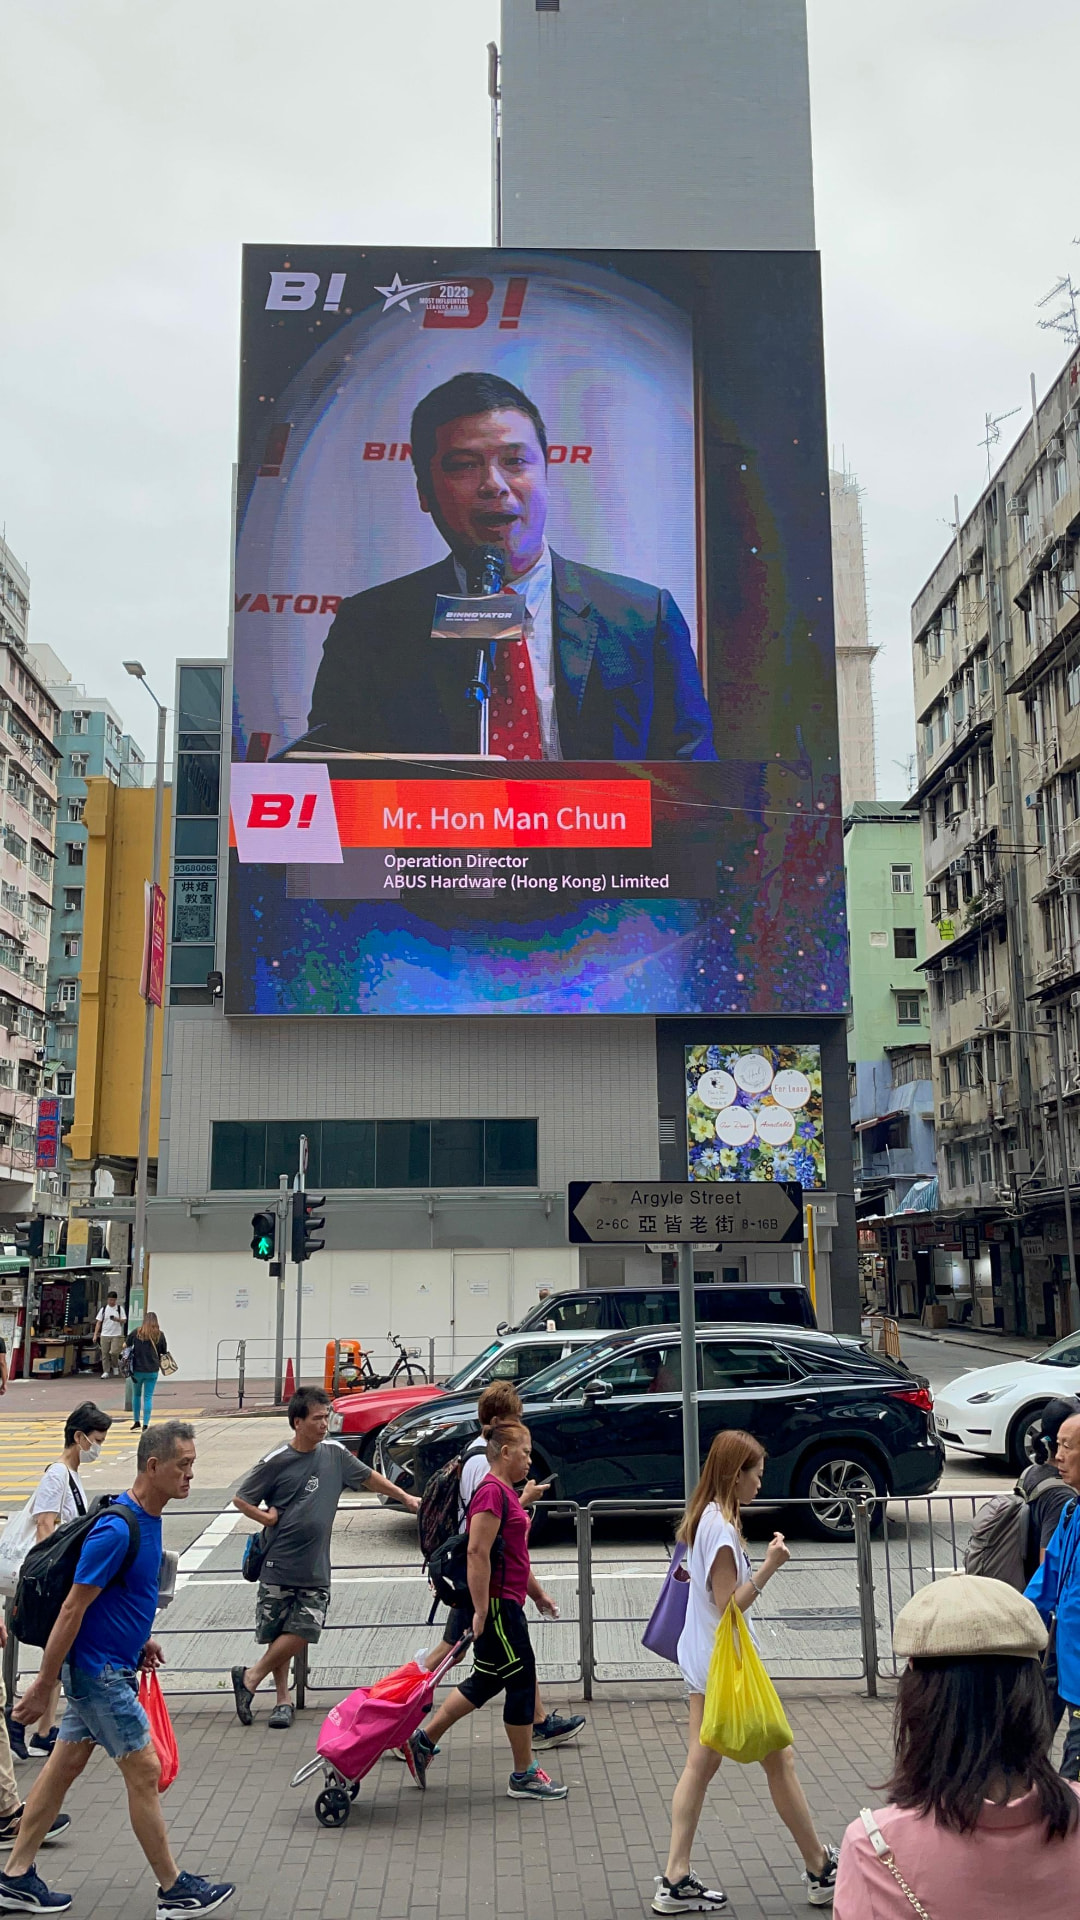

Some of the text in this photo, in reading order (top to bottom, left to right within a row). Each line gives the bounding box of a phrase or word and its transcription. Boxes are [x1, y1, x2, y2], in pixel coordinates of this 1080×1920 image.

[265, 271, 347, 311] B!
[439, 286, 468, 298] 2023
[246, 794, 318, 829] B!
[382, 806, 627, 831] Mr. Hon Man Chun
[384, 854, 529, 871] Operation Director
[181, 881, 209, 892] 烘焙
[383, 873, 669, 893] ABUS Hardware (Hong Kong) Limited
[185, 893, 212, 904] 教室
[774, 1084, 808, 1093] For Lease
[631, 1190, 742, 1208] Argyle Street
[596, 1214, 778, 1234] 2-6C 亞皆老街 8-16B
